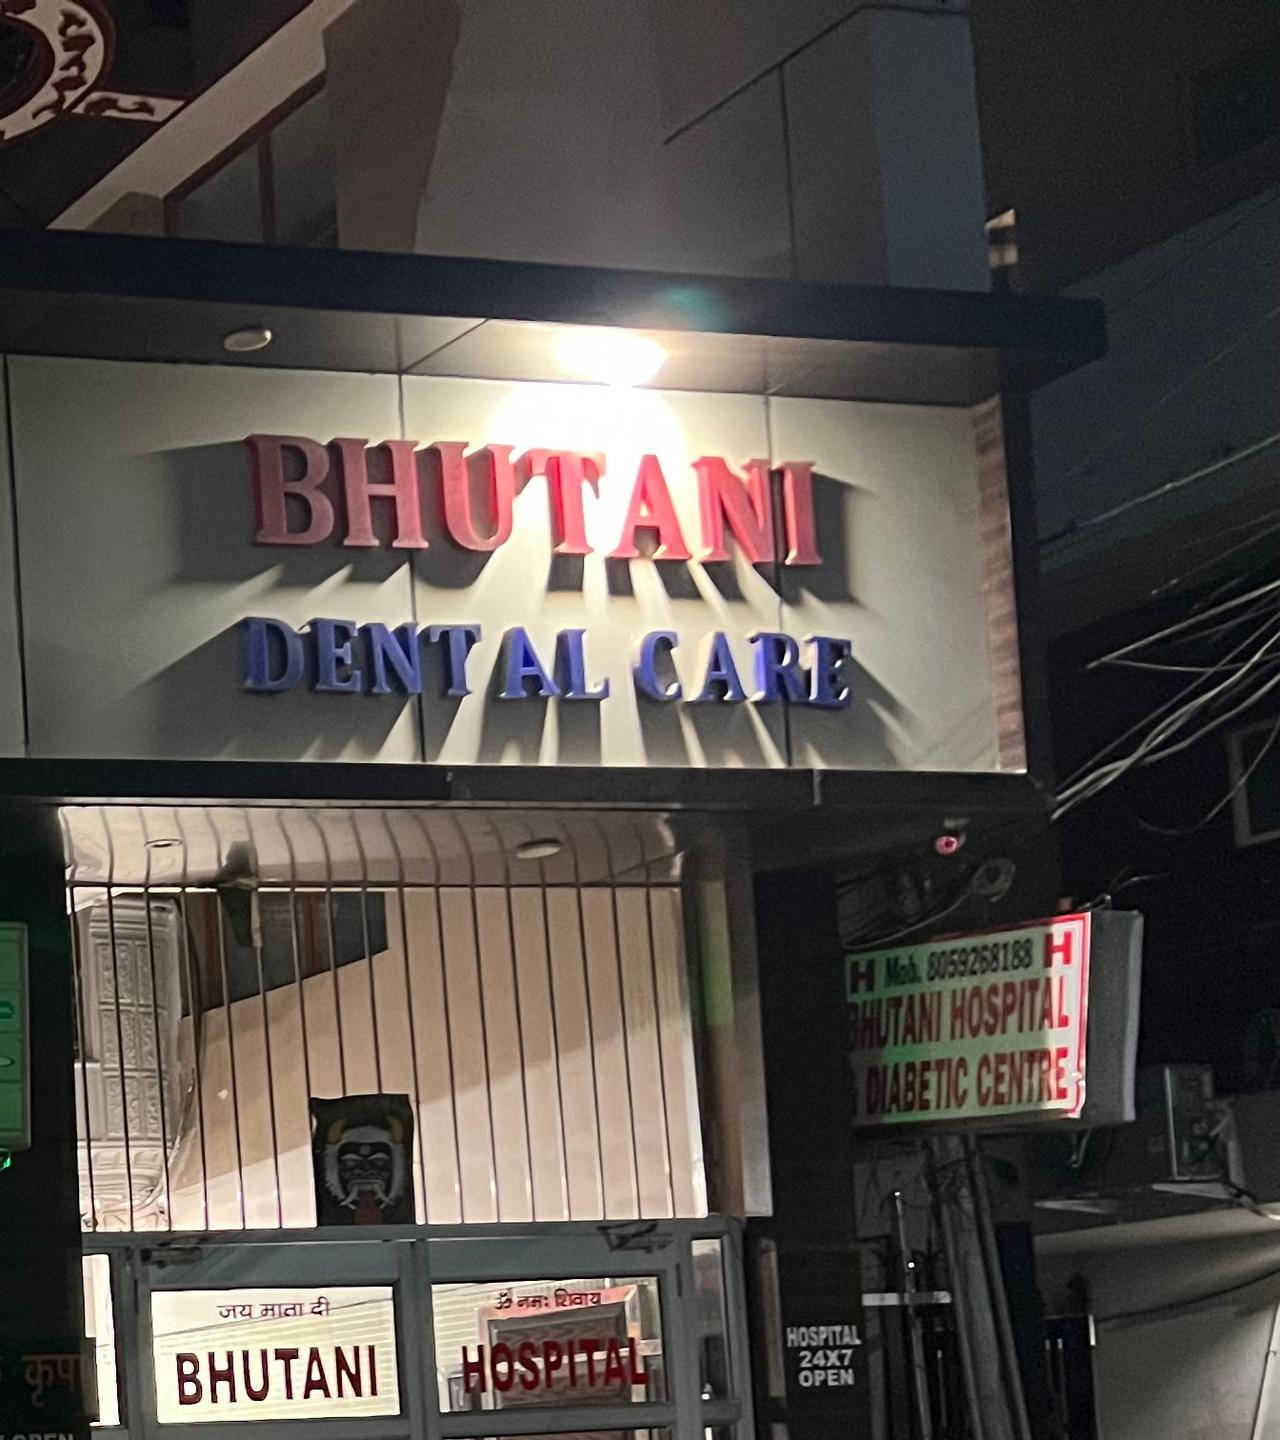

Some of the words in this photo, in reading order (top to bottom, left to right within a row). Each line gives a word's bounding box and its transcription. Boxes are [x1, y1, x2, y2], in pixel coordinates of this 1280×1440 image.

[243, 432, 824, 567] BHUTANI
[240, 614, 611, 702] DENTAL
[632, 629, 854, 711] CARE
[1043, 931, 1073, 968] H
[949, 974, 1071, 1041] HOSPITAL
[865, 1055, 969, 1115] DIABETIC
[975, 1047, 1068, 1108] CENTRE
[215, 1303, 255, 1320] जय
[259, 1302, 305, 1318] माता
[308, 1295, 331, 1317] दी
[785, 1324, 862, 1348] HOSPITAL
[175, 1344, 379, 1406] BHUTANI
[461, 1336, 651, 1394] HOSPITAL
[797, 1367, 856, 1388] OPEN
[798, 1348, 854, 1368] 24X7
